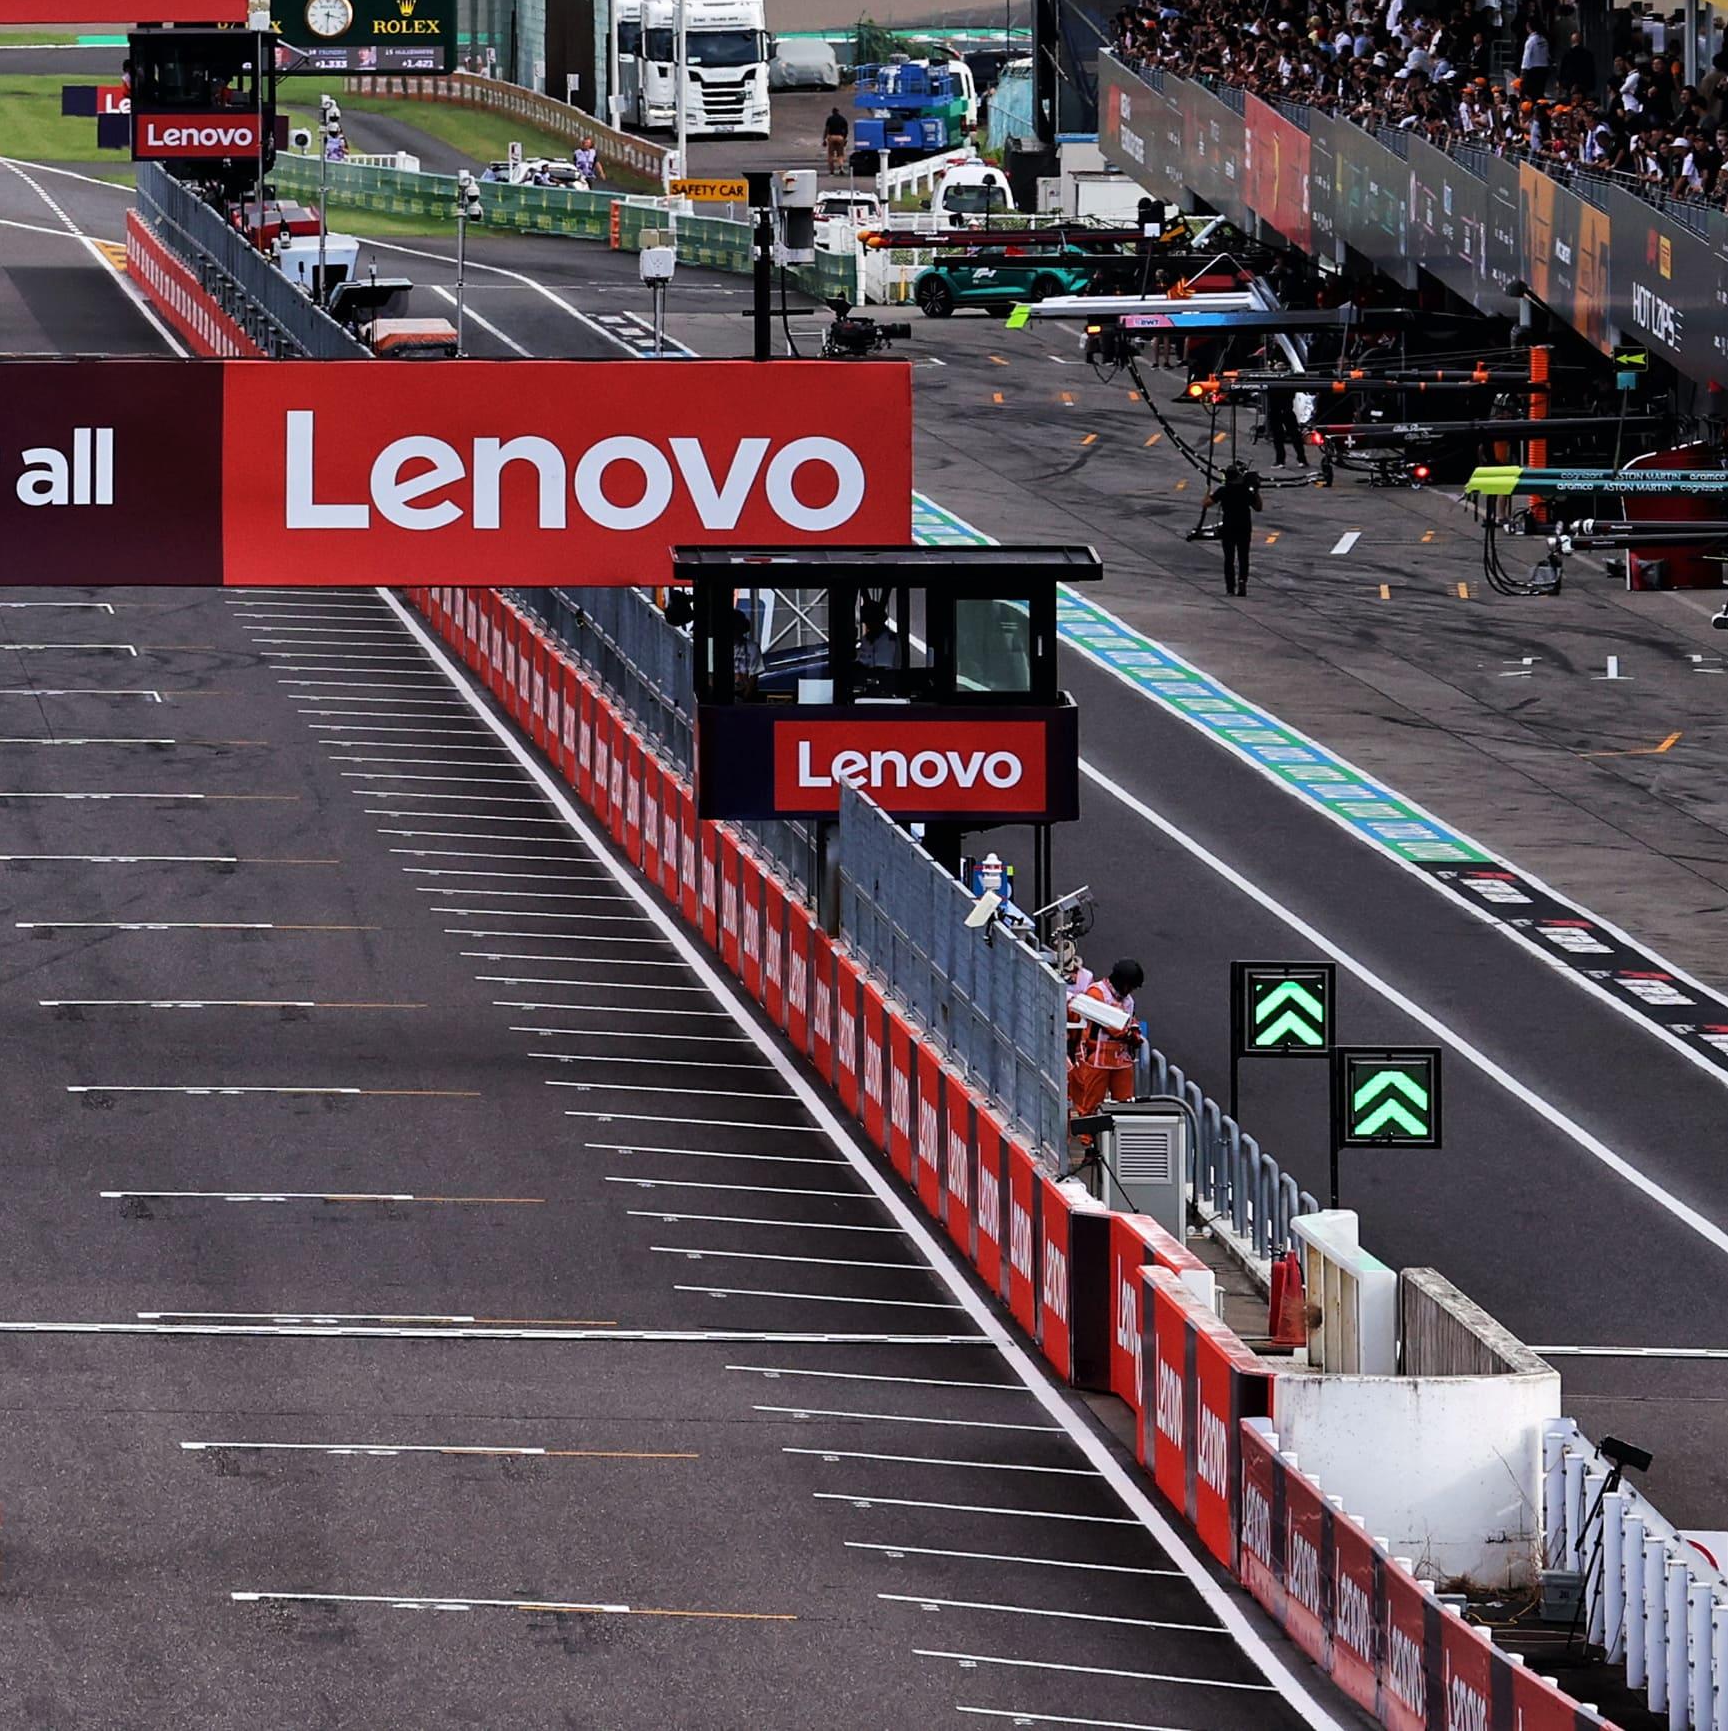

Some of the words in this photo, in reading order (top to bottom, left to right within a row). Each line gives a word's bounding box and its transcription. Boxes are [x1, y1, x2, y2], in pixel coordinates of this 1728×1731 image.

[373, 20, 441, 34] ROLEX
[147, 124, 253, 146] Lenovo
[671, 184, 717, 196] SAFETY
[719, 184, 744, 196] CAR
[16, 427, 114, 505] all
[286, 410, 866, 532] Lenovo
[1644, 472, 1682, 481] MARTIN
[1557, 483, 1593, 491] aramco
[1603, 483, 1632, 492] ASTON
[1635, 483, 1672, 492] MARTIN
[798, 741, 1022, 789] Lenovo
[1156, 1333, 1184, 1451] Lenovo
[1197, 1376, 1229, 1501] Lenovo
